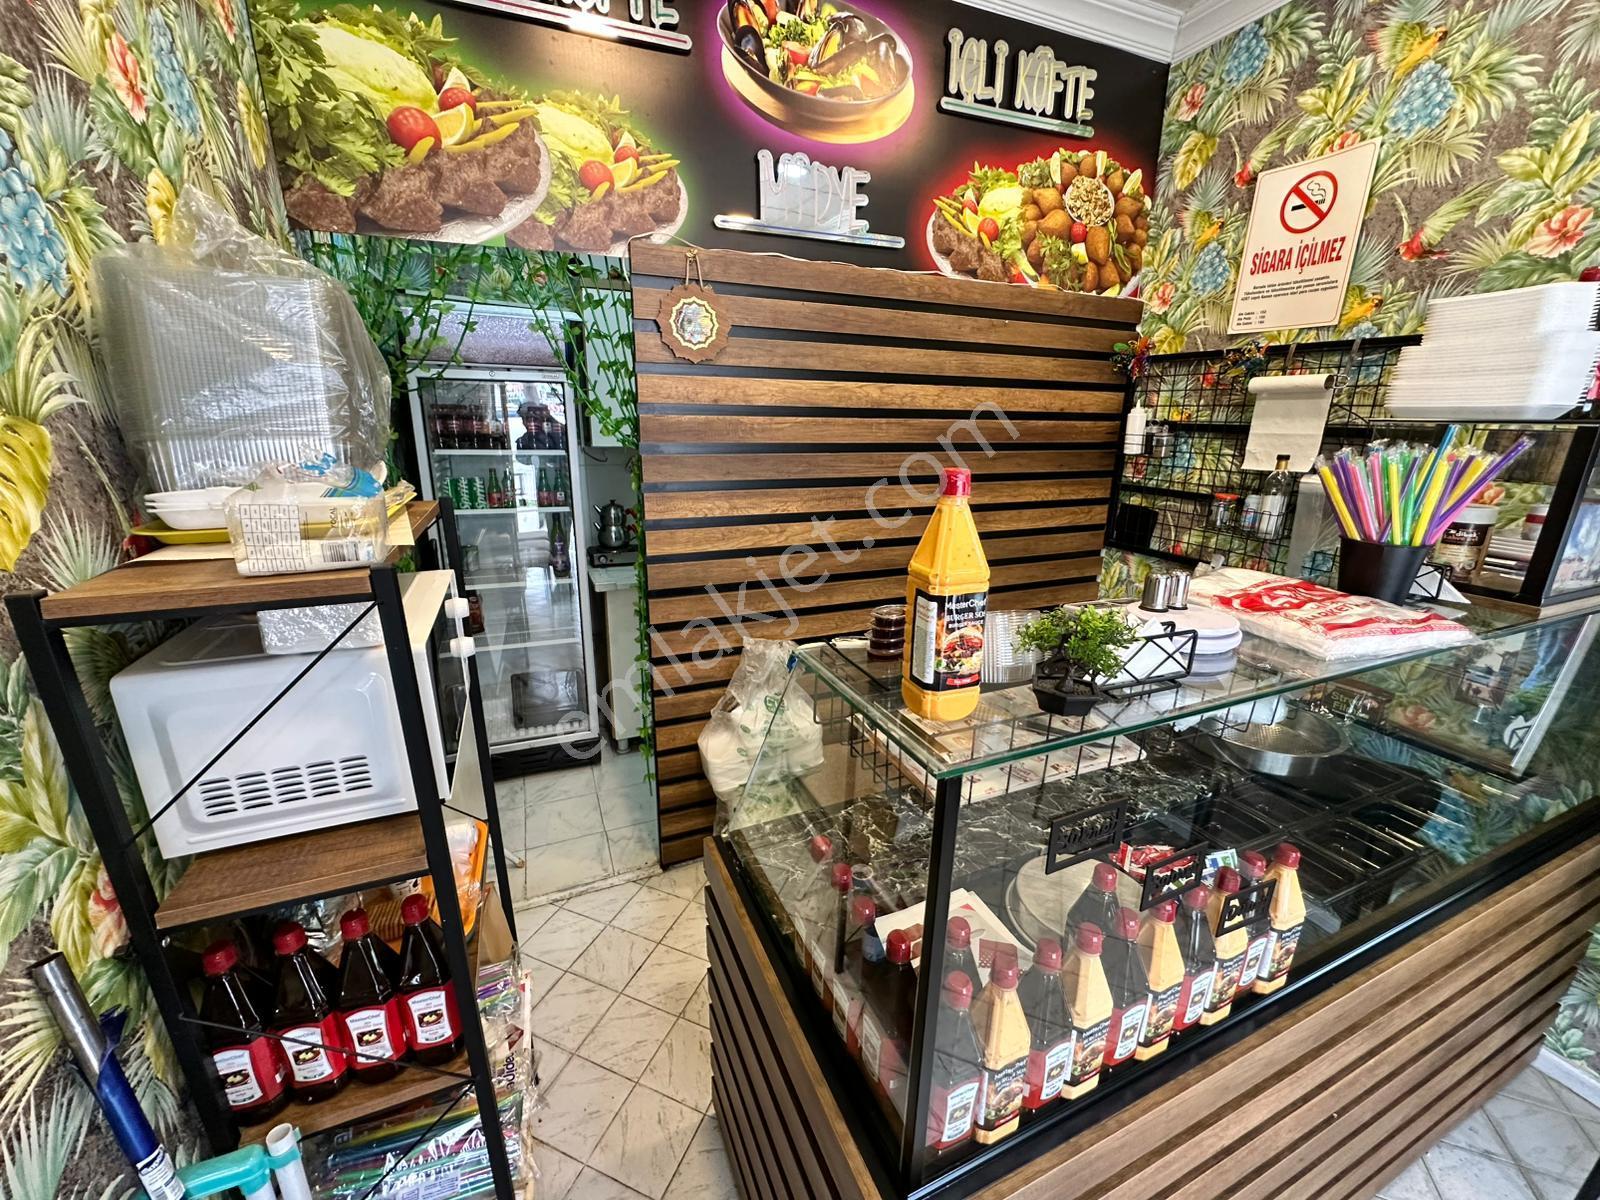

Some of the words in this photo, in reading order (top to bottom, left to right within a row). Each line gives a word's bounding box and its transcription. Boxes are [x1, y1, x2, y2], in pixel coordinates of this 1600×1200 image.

[948, 27, 1009, 105] İÇLİ
[1014, 45, 1098, 121] KÖFTE
[757, 148, 872, 235] MİDYE
[1250, 246, 1293, 276] SİGARA
[1295, 236, 1346, 274] İÇİLMEZ
[458, 477, 470, 509] Sprite
[474, 476, 487, 509] Sprite
[945, 598, 987, 609] MasterChef
[945, 612, 974, 622] BURGER
